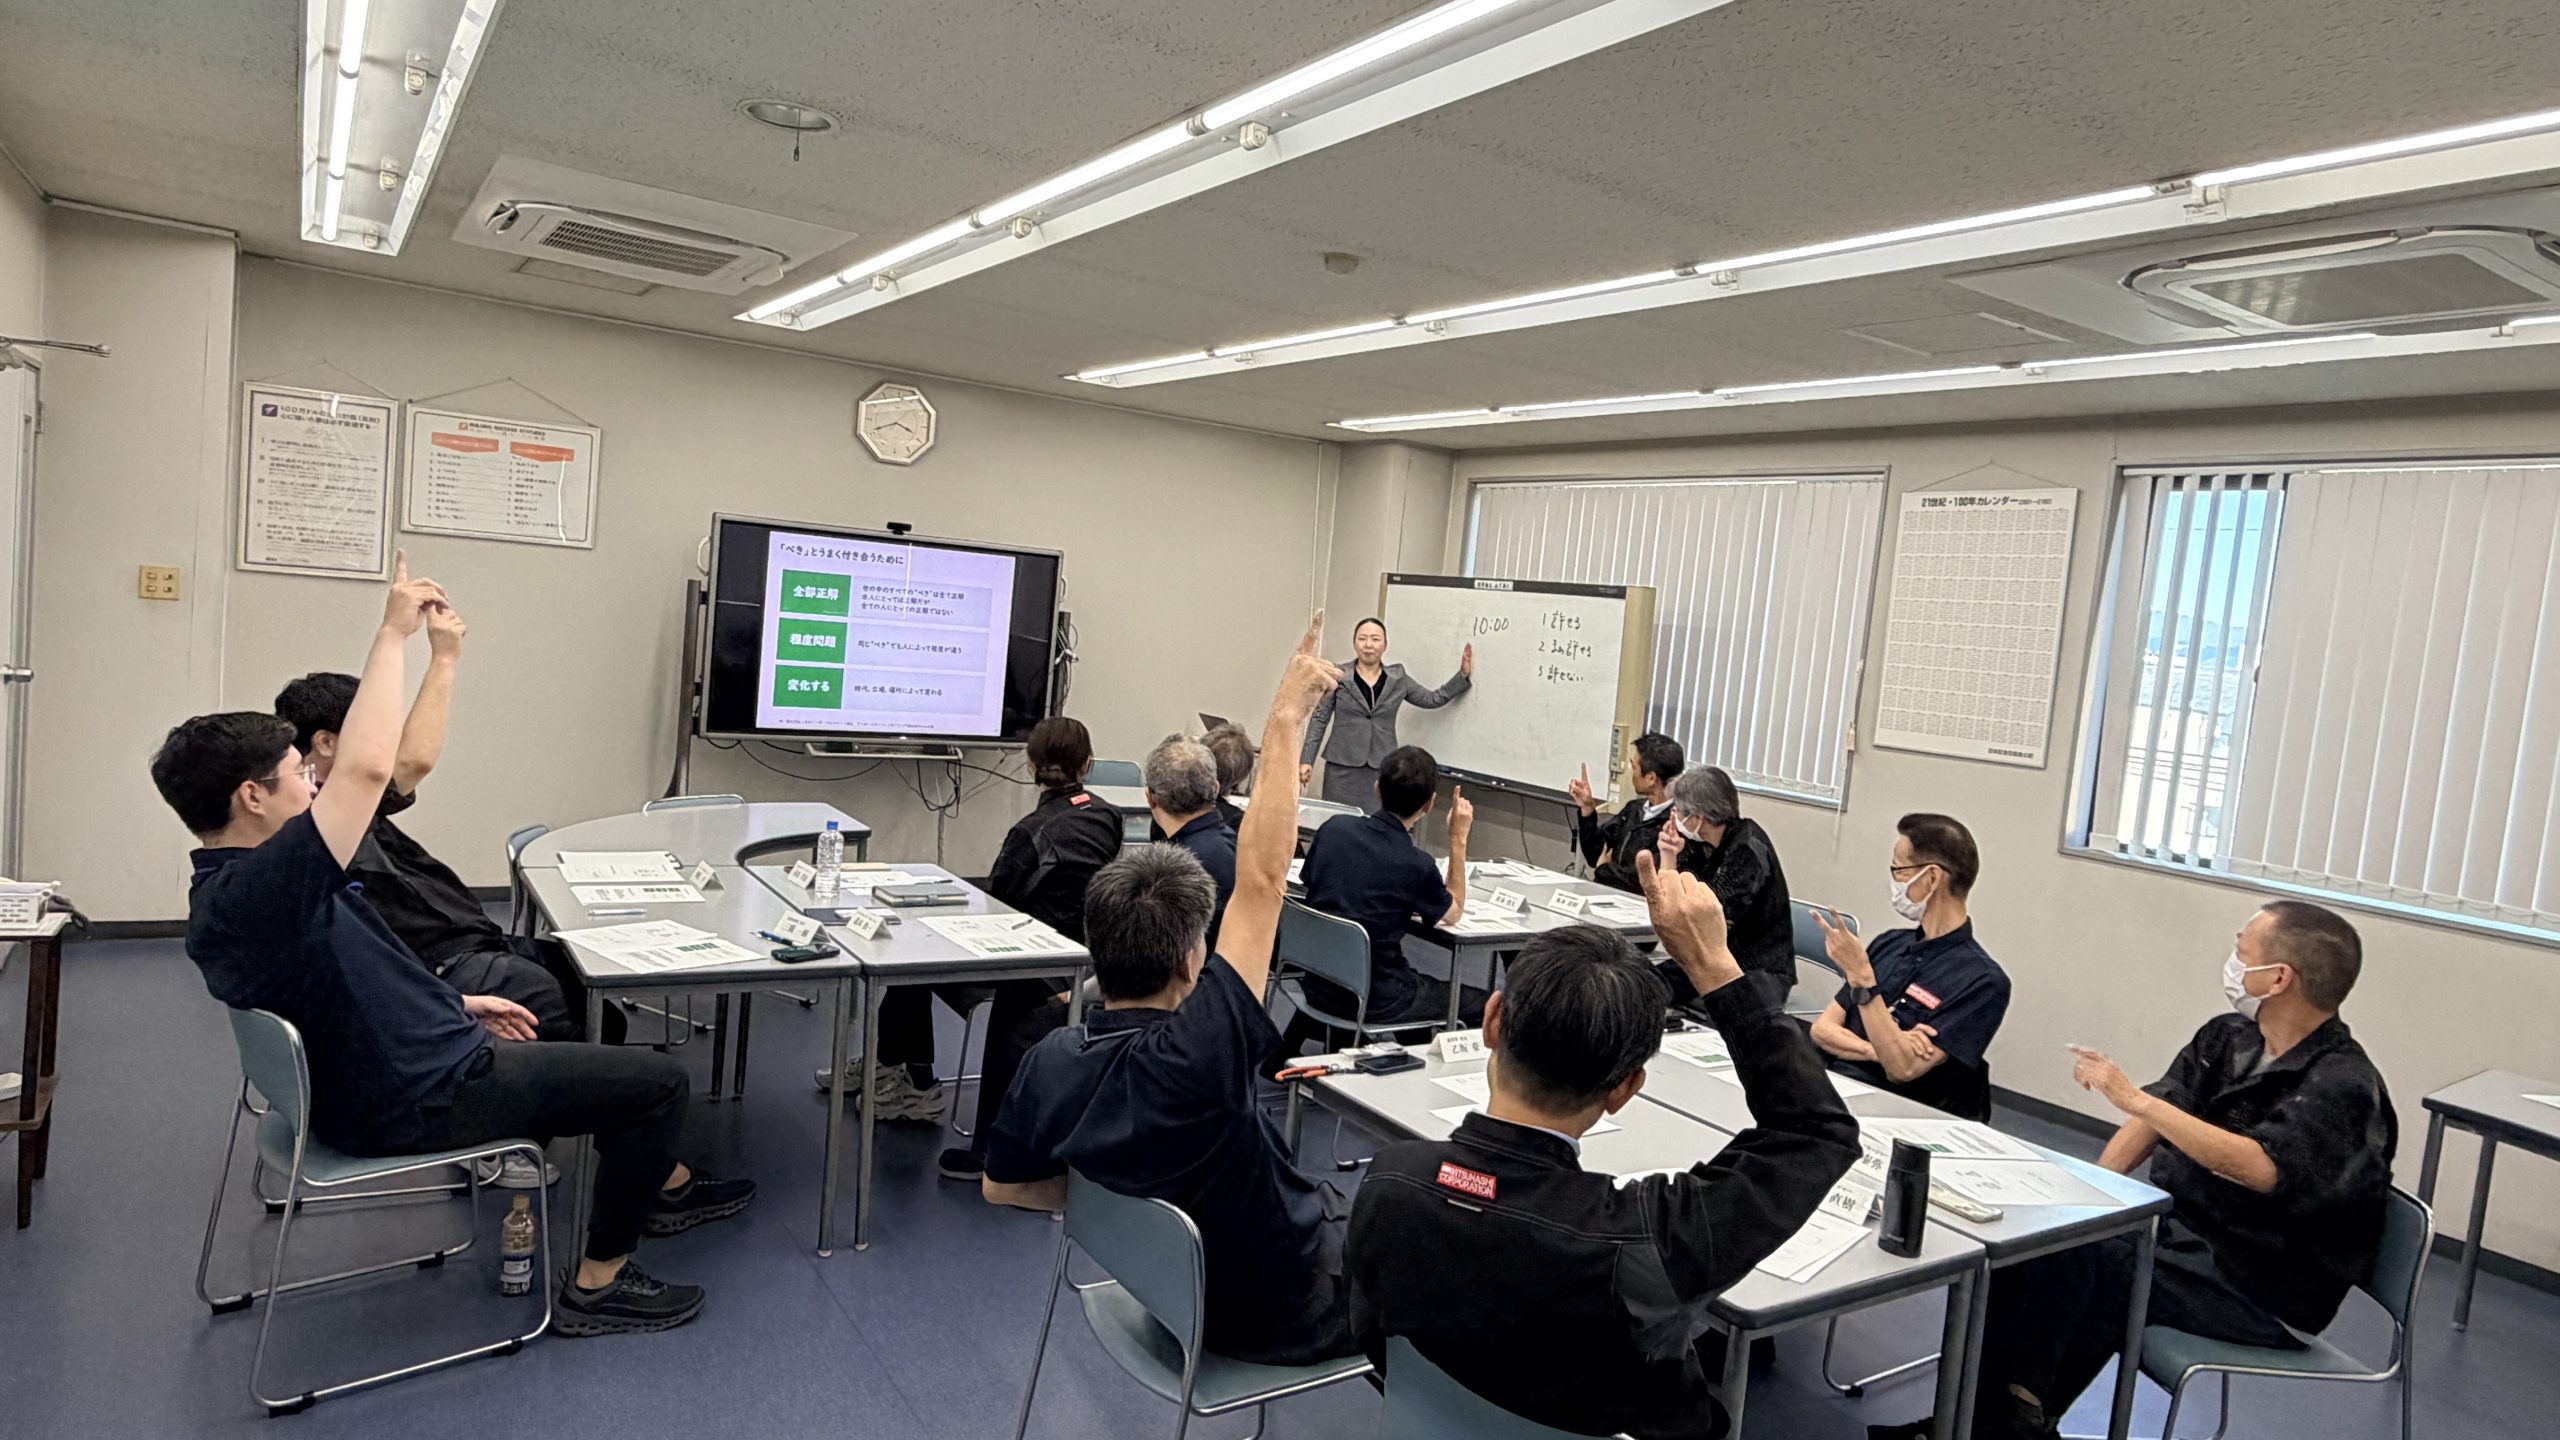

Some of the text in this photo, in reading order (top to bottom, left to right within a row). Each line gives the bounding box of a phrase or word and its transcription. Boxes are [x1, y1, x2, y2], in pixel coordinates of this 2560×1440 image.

[780, 543, 904, 565] 「べき」とうまく付き合うために
[793, 585, 839, 600] 全部正解
[1473, 616, 1509, 637] 10:00
[789, 633, 837, 648] 程度問題
[1538, 640, 1545, 652] 2
[1538, 665, 1543, 677] 3
[787, 678, 830, 692] 変化する
[1439, 1172, 1492, 1196] CORPORATION
